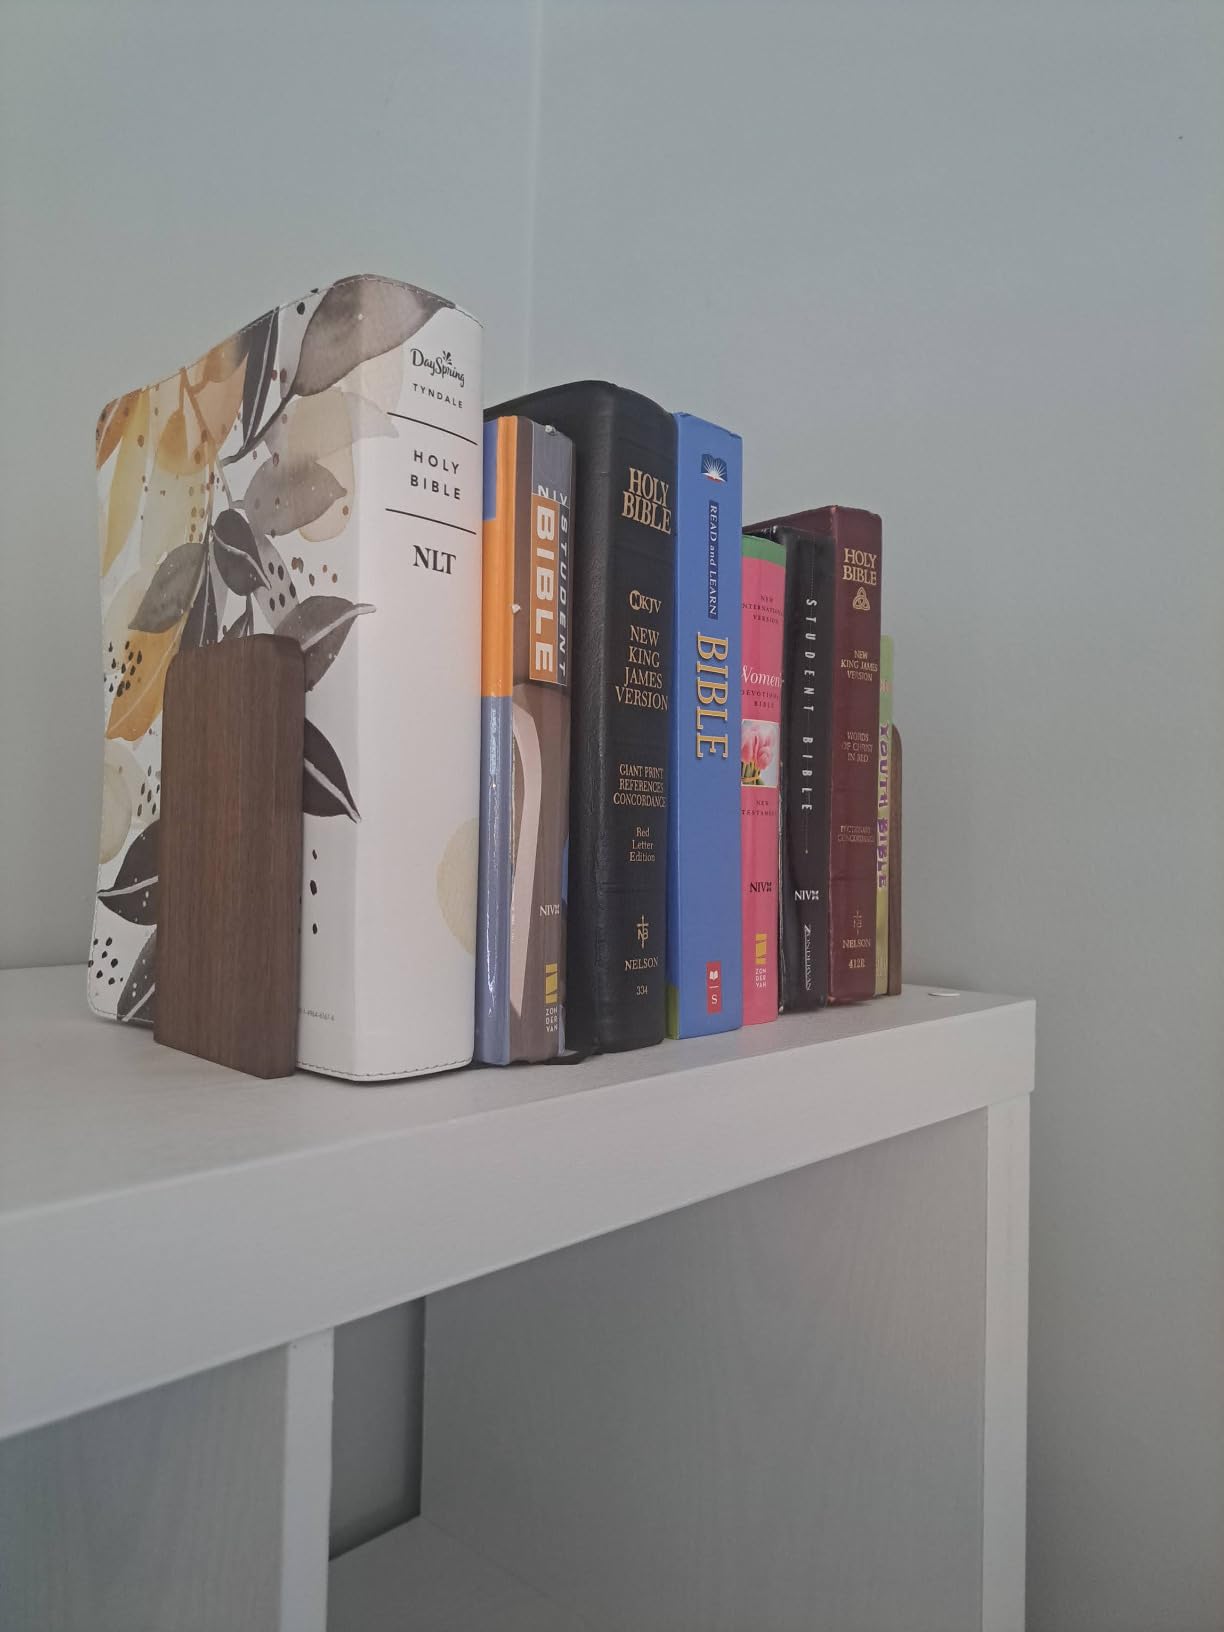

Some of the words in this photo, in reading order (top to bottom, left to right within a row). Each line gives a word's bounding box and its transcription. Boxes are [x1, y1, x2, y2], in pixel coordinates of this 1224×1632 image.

[410, 348, 465, 387] DaySpring
[413, 383, 463, 408] TYNDALE
[413, 450, 459, 475] HOLY
[410, 474, 461, 500] BIBLE
[537, 484, 568, 506] NIV
[628, 467, 669, 508] HOLY
[621, 491, 672, 535] BIBLE
[709, 504, 718, 542] READ
[412, 545, 457, 575] NLT
[709, 545, 717, 566] and
[844, 548, 877, 569] HOLY
[842, 565, 877, 586] BIBLE
[535, 505, 555, 673] BIBLE
[559, 512, 569, 677] STUDENT
[708, 569, 717, 616] LEARN
[630, 624, 660, 648] NEW
[628, 646, 660, 668] KING
[803, 598, 818, 711] STUDENT
[840, 658, 859, 669] KING
[861, 661, 878, 672] JAMES
[854, 650, 868, 660] NEW
[624, 666, 663, 689] JAMES
[847, 670, 873, 682] VERSION
[615, 686, 669, 712] VERSION
[696, 631, 729, 759] BIBLE
[619, 763, 643, 777] GIANT
[645, 766, 664, 780] PRINT
[801, 736, 814, 810] BIBLE
[878, 723, 889, 808] YOUTH
[619, 778, 664, 793] REFERENCES
[613, 792, 667, 808] CONCORDANCE
[636, 826, 650, 837] Red
[632, 839, 654, 850] Letter
[877, 817, 889, 889] BIBLE
[629, 851, 656, 862] Edition
[749, 882, 767, 893] NIV
[794, 890, 812, 901] NIV
[539, 904, 556, 917] NIV
[842, 938, 871, 949] NELSON
[624, 956, 659, 971] NELSON
[636, 986, 648, 996] 334
[711, 993, 718, 1005] S
[545, 1006, 558, 1016] ZON
[545, 1015, 558, 1025] DER
[545, 1024, 558, 1033] VAN
